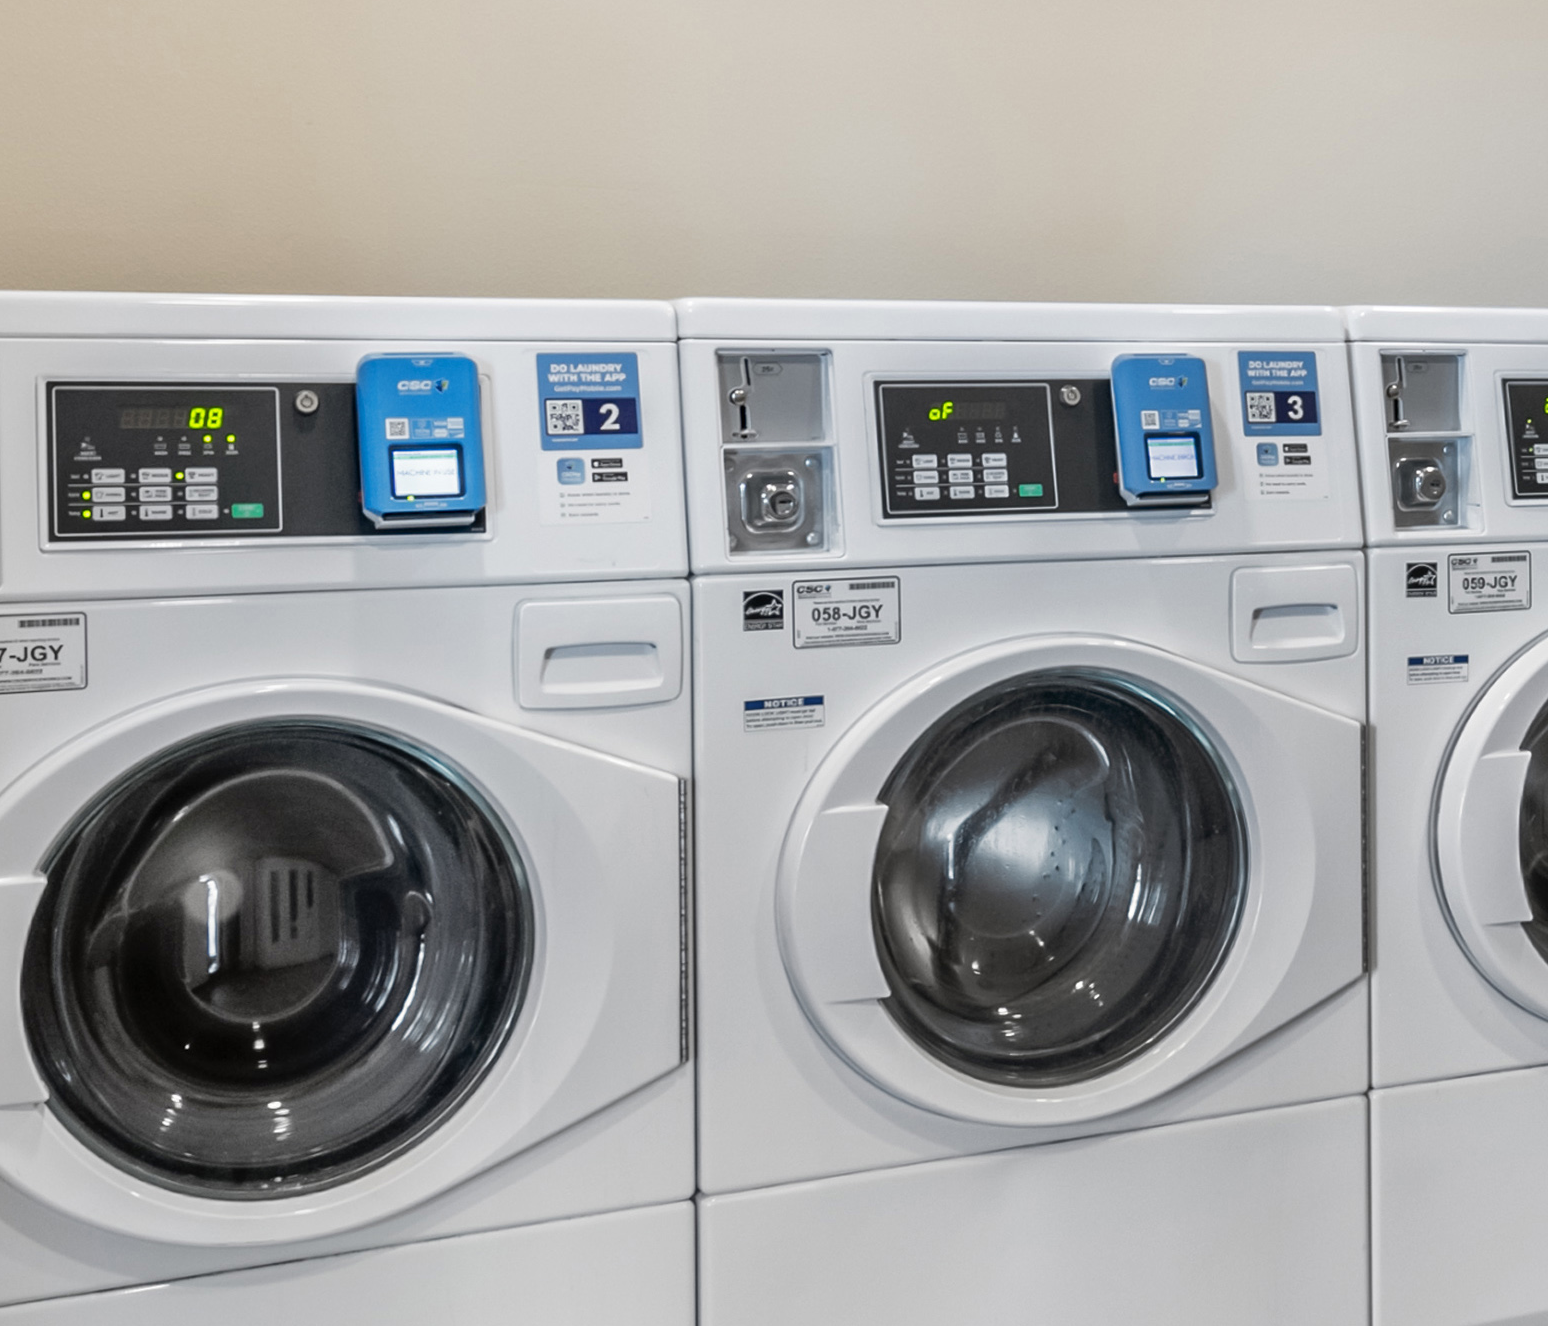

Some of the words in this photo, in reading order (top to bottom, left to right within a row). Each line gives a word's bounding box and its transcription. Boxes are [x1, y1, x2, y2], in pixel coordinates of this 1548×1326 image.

[550, 364, 567, 373] DO
[570, 364, 622, 373] LAUNDRY
[548, 374, 577, 382] WITH
[580, 374, 601, 382] THE
[604, 373, 626, 382] APP
[1149, 378, 1175, 386] CSC
[397, 380, 432, 390] CSC
[1288, 395, 1304, 419] 3
[189, 408, 223, 429] 08
[599, 403, 620, 430] 2
[1463, 575, 1517, 590] 059-JGY
[797, 585, 823, 593] CSC
[812, 605, 883, 622] 058-JGY
[1423, 656, 1454, 664] NOTICE
[764, 698, 804, 708] NOTICE
